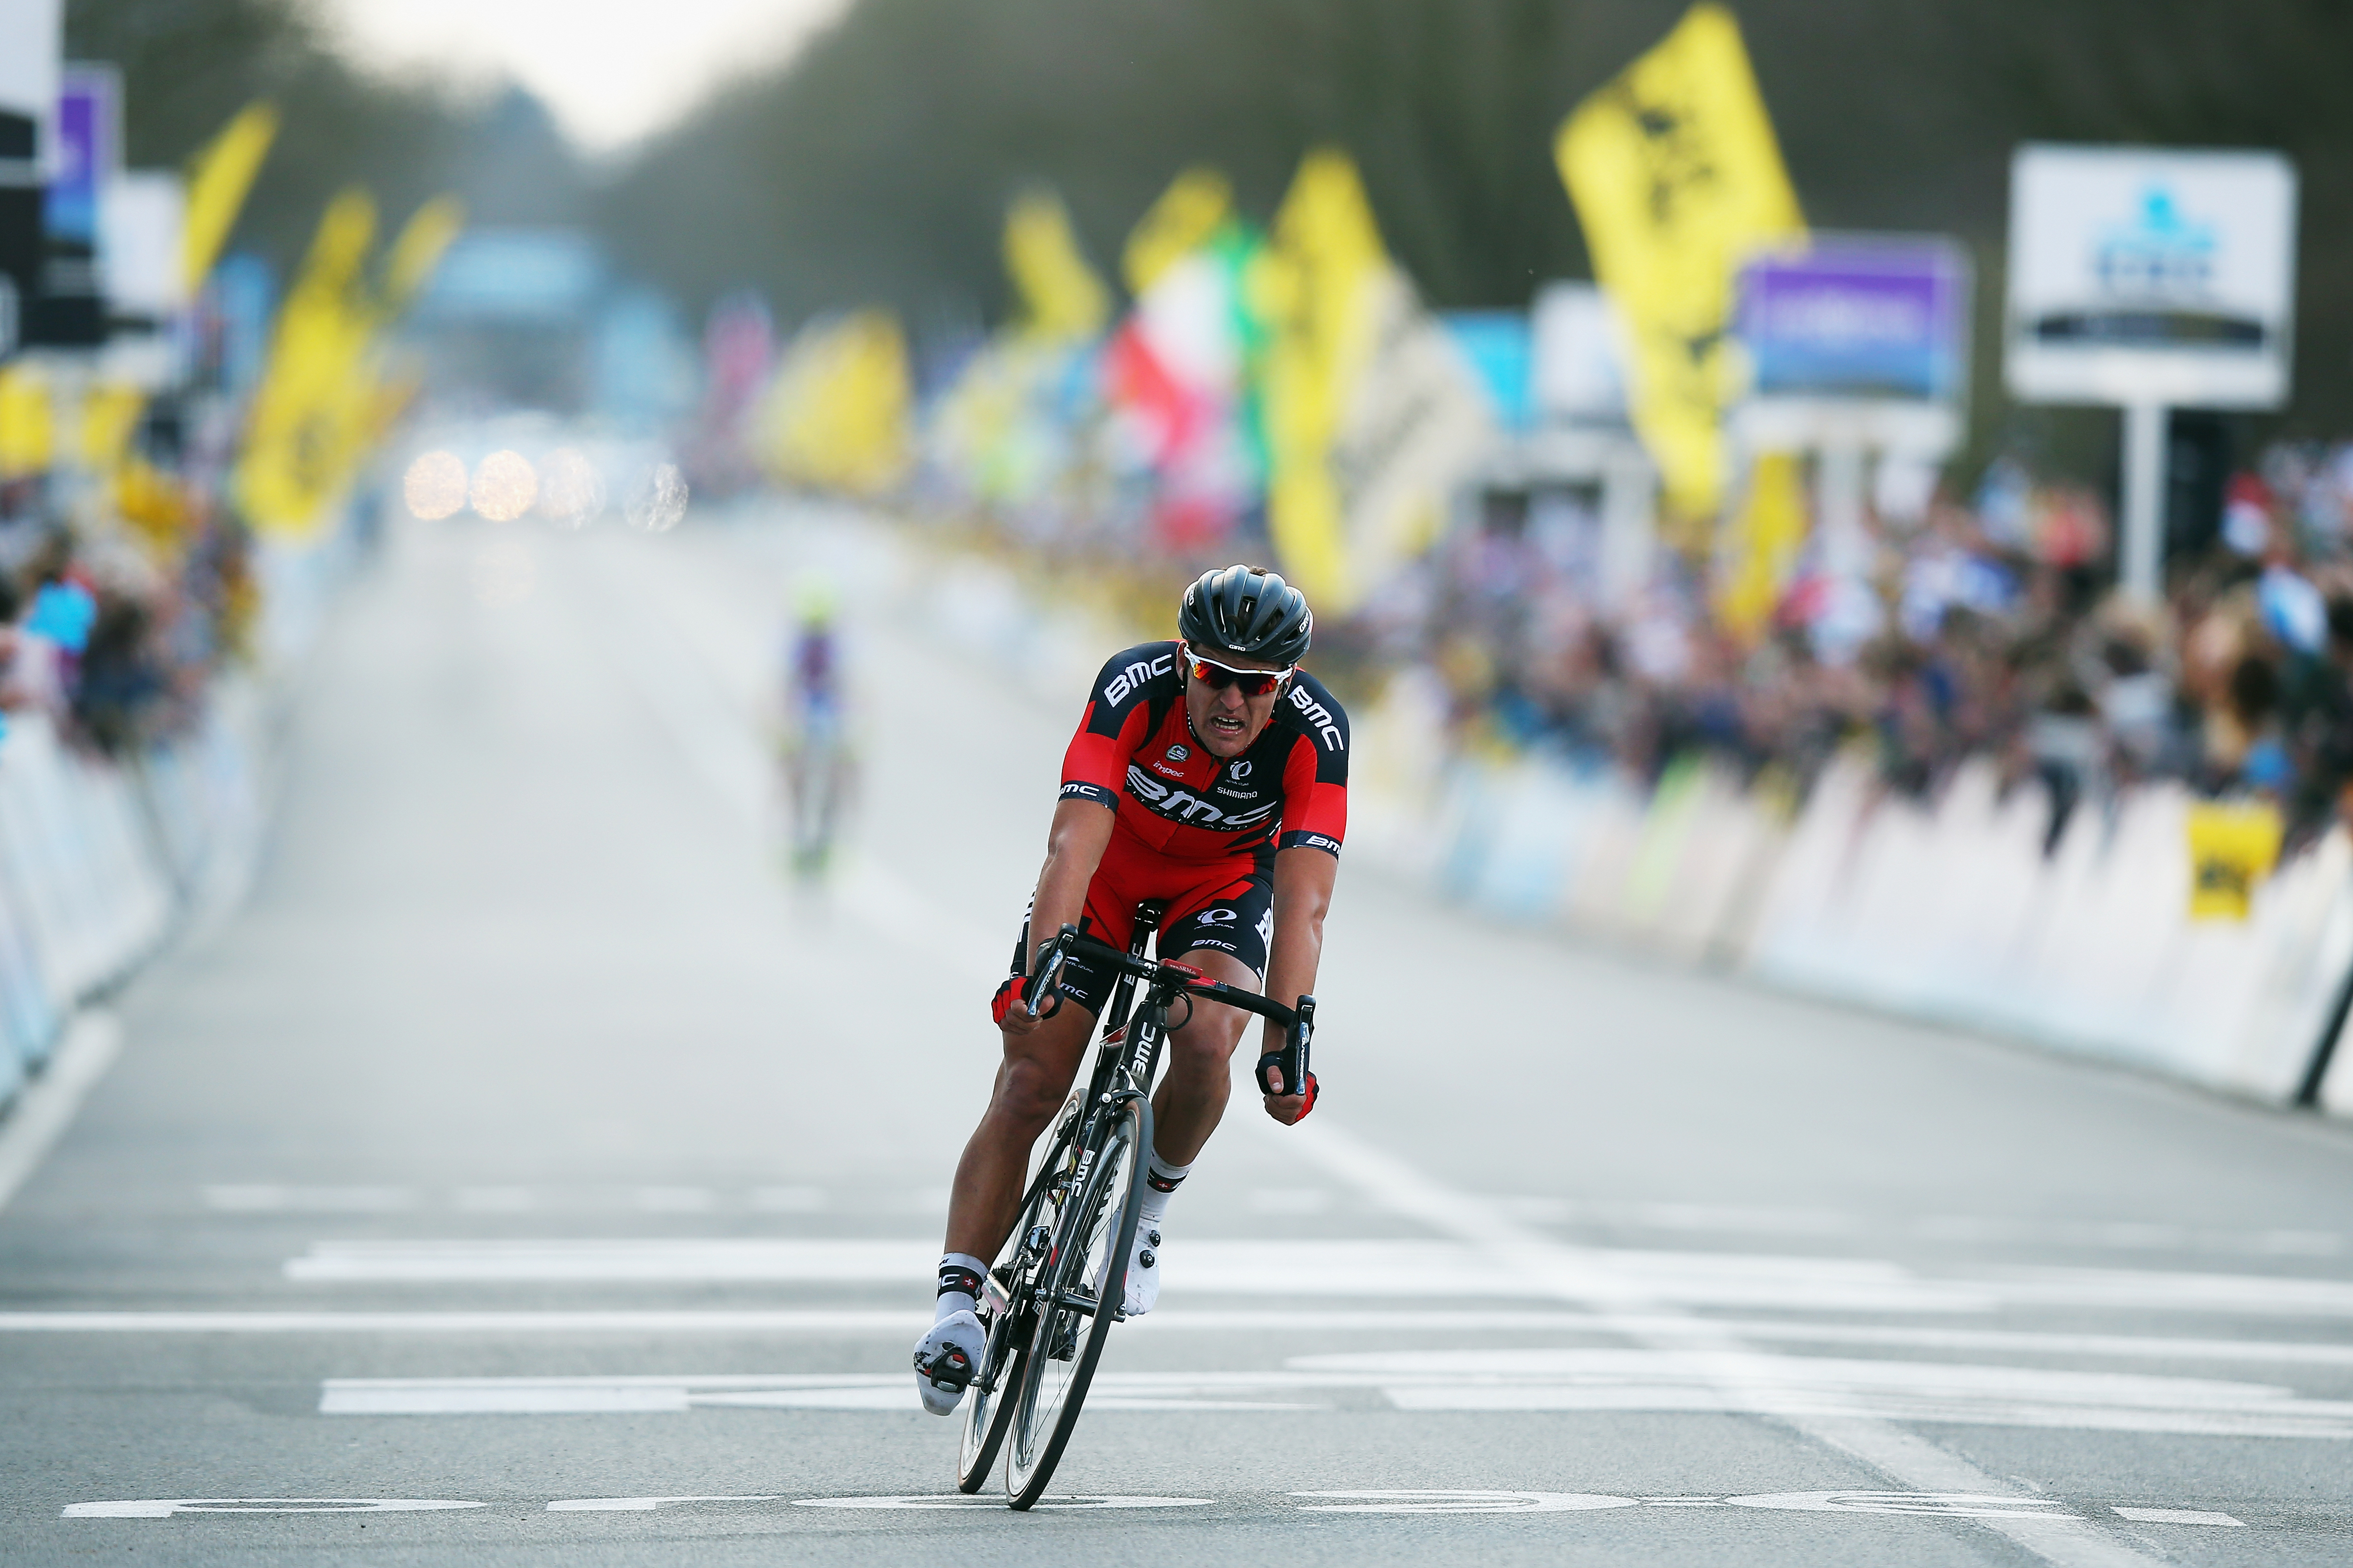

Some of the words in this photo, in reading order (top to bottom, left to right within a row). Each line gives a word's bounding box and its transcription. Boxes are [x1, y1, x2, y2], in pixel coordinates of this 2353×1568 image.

[1228, 643, 1247, 652] GIRO
[1104, 653, 1172, 708] BMC
[1287, 684, 1345, 752] BMC
[1153, 760, 1185, 777] impec
[1126, 765, 1277, 825] BMC
[1217, 786, 1258, 799] SHIMANO
[1305, 835, 1341, 855] BM
[1191, 939, 1237, 952] BMC
[1059, 982, 1088, 999] MC
[1129, 1021, 1156, 1081] BMC
[1070, 1149, 1096, 1197] BMC
